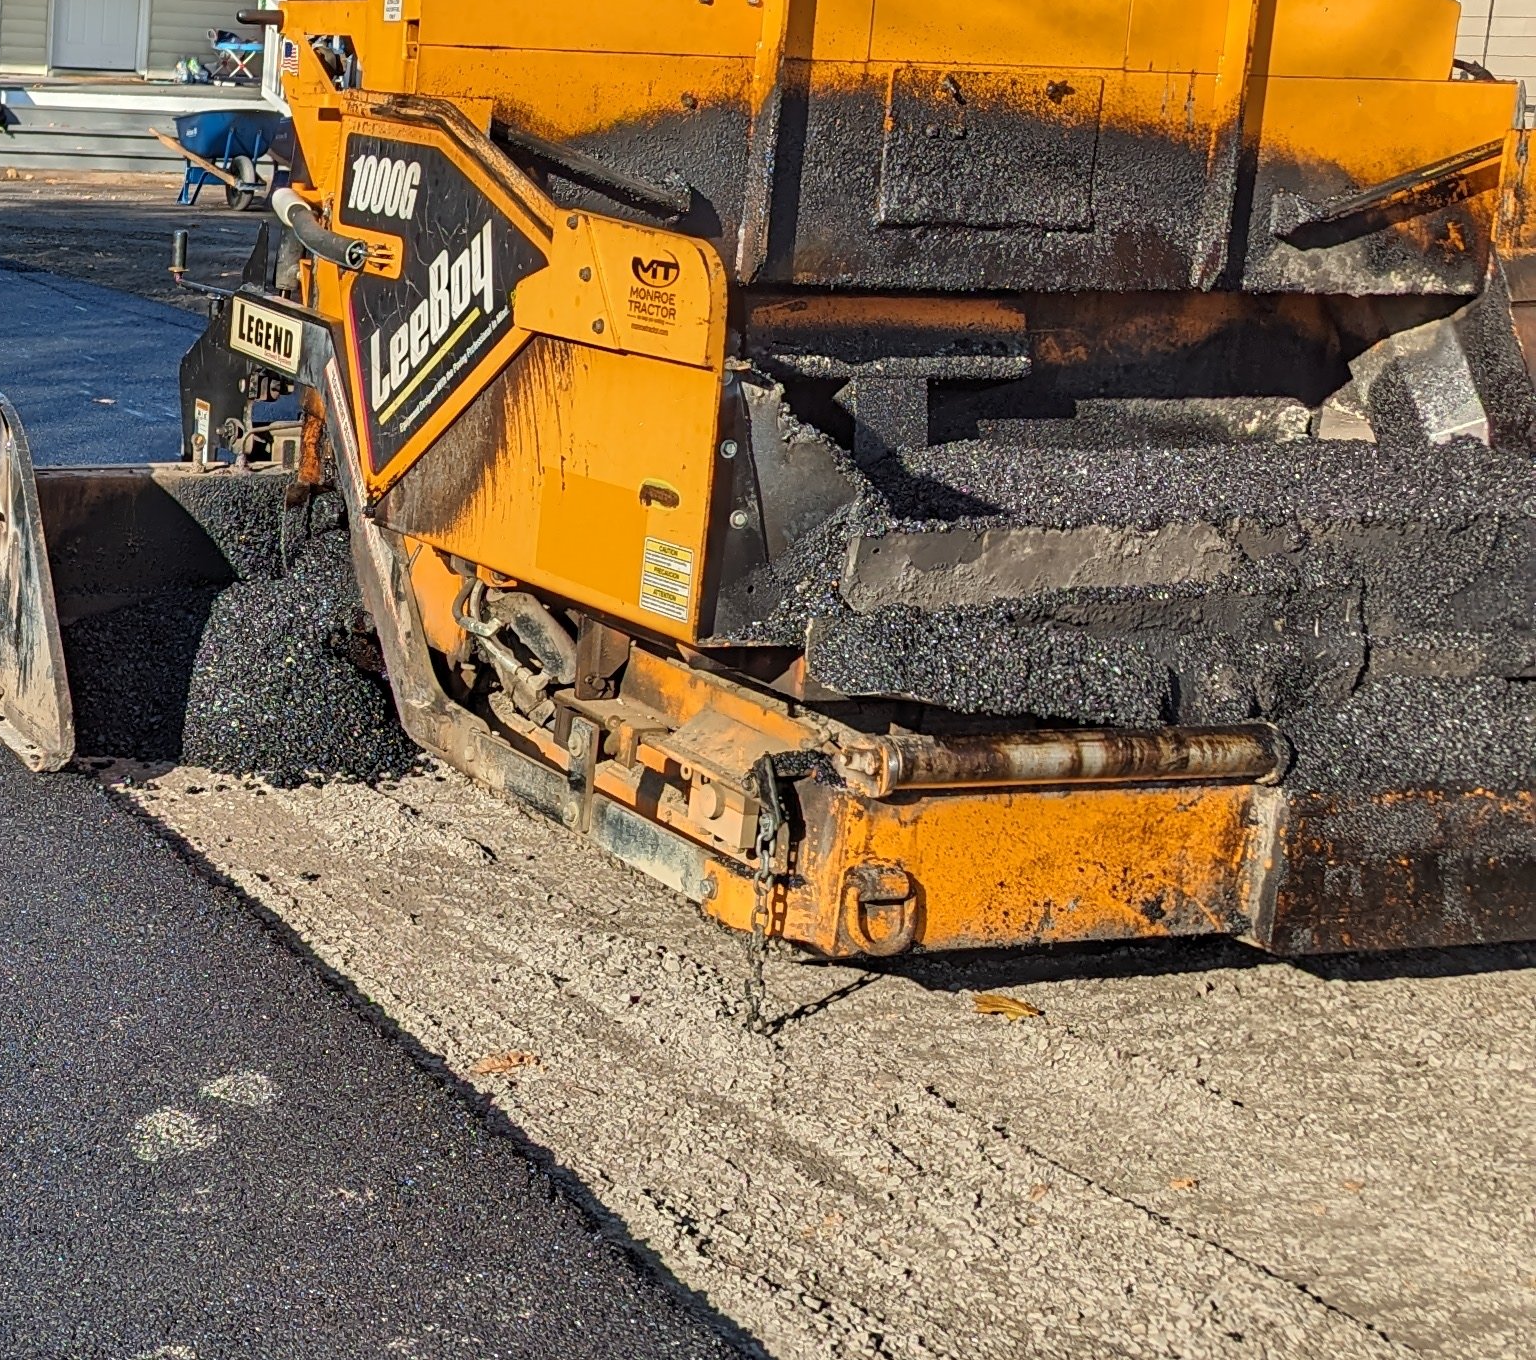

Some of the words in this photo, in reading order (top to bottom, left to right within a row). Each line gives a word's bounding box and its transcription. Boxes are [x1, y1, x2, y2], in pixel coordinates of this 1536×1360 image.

[348, 154, 421, 220] 1000G
[629, 285, 676, 306] MONROE
[370, 219, 494, 412] LeeBoy
[628, 299, 677, 320] TRACTOR
[238, 303, 294, 359] LEGEND
[658, 545, 679, 556] CAUTION
[653, 589, 677, 601] ATTENTION
